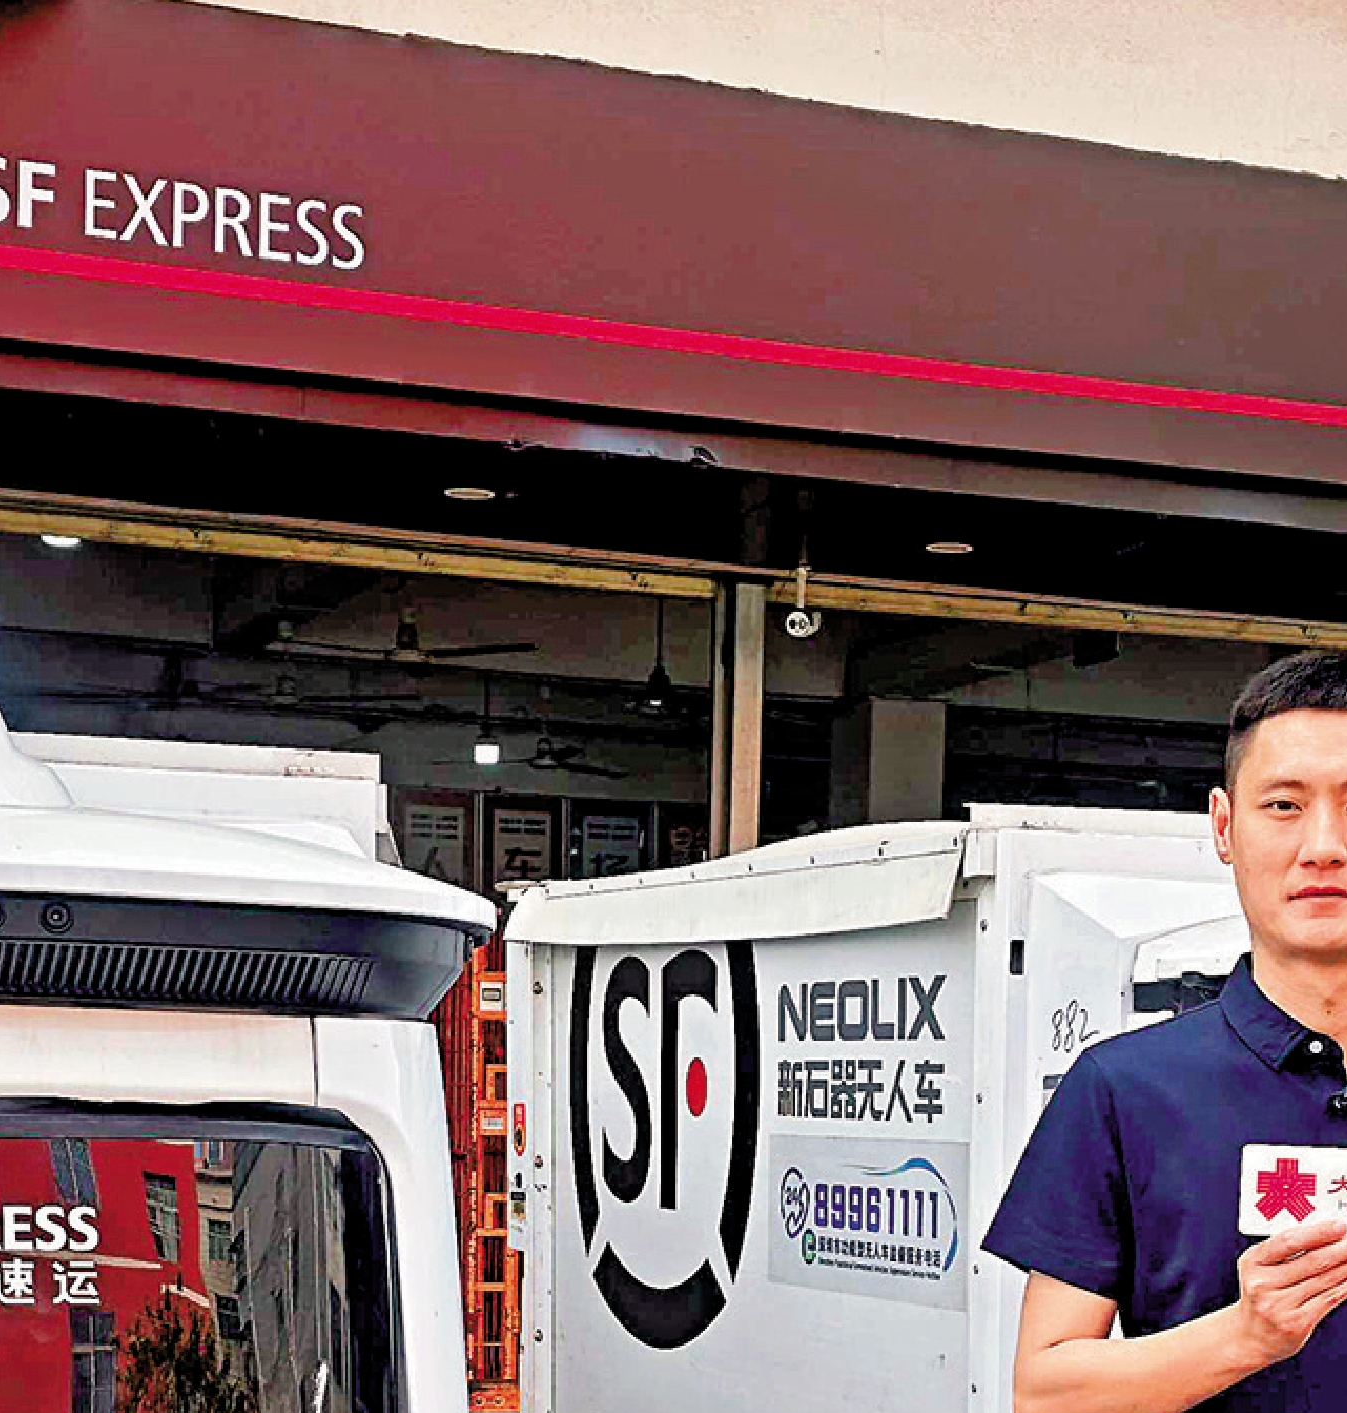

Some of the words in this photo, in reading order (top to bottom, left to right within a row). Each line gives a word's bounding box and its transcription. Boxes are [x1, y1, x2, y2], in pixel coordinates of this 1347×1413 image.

[84, 168, 366, 270] EXPRESS
[778, 974, 947, 1042] NEOLIX
[1052, 999, 1100, 1053] 882
[602, 949, 719, 1210] SF
[778, 1059, 946, 1123] 新石器无人车
[814, 1183, 939, 1239] 89961111
